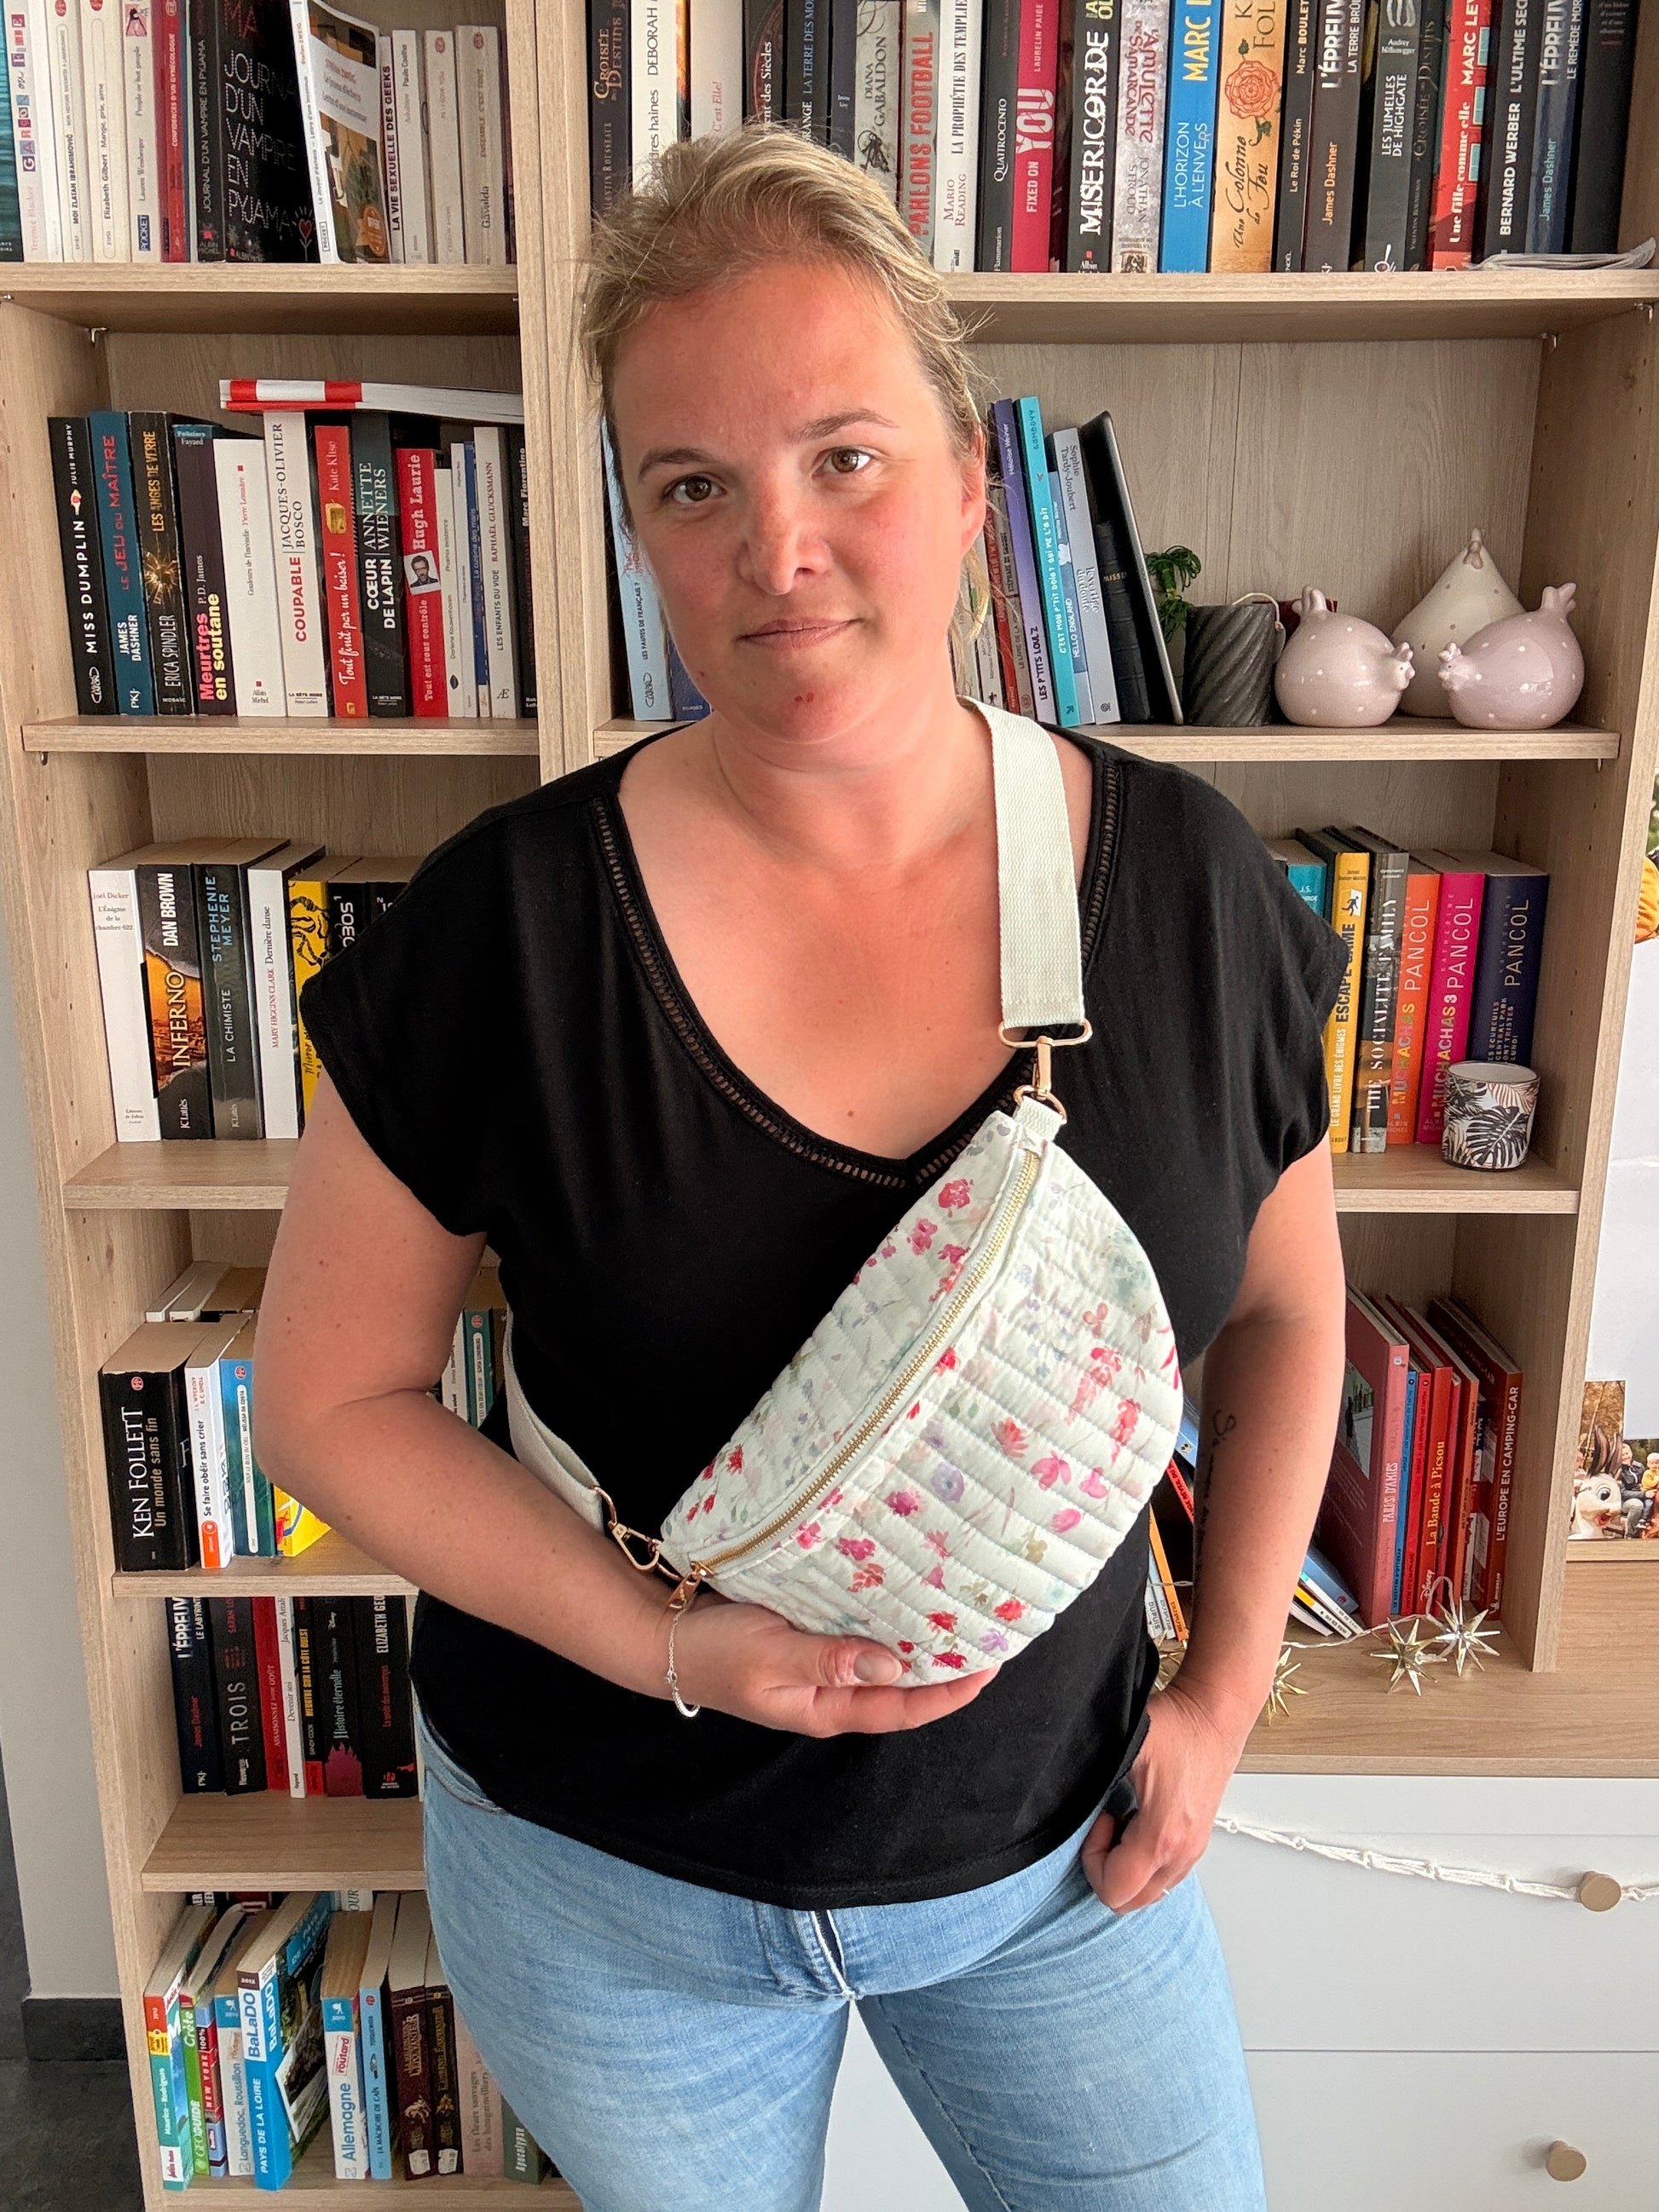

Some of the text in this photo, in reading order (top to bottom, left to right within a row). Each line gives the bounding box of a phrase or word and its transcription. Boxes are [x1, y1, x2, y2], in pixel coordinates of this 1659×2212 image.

[647, 7, 659, 130] haines DEBORAH
[761, 42, 772, 101] des Siècles
[1033, 3, 1043, 72] LAURELIN PAIGE
[1182, 16, 1211, 81] MARC
[1296, 0, 1309, 74] Marc BOULET
[1347, 26, 1360, 72] LA TERRE
[1567, 25, 1581, 79] LE REMÈDE
[864, 62, 873, 99] DIANA
[875, 36, 886, 127] GABALDON
[1381, 75, 1396, 154] LES JUMELLES
[1393, 74, 1407, 156] DE HIGHGATE
[198, 40, 211, 212] JOURNAL D'UN VAMPIRE EN PYJAMA
[383, 66, 400, 231] LA VIE SEXUELLE DES GEEKS
[908, 32, 933, 236] PARLONS FOOTBALL
[1015, 88, 1054, 212] FIXED ON YOU
[1079, 31, 1108, 235] MISERICORDE
[1289, 118, 1302, 192] Le Roi de Pékin
[1500, 29, 1526, 235] BERNARD WERBER L'ULTIME
[100, 154, 109, 181] Gilbert
[101, 184, 111, 219] Elizabeth
[1125, 164, 1136, 214] STROUD
[1137, 157, 1149, 222] JONATHAN
[1174, 123, 1189, 207] L'HORIZON
[1322, 141, 1338, 225] James Dashner
[1449, 101, 1470, 243] Une fille comme elle
[1540, 138, 1557, 221] James Dashner
[139, 215, 149, 251] POCKET
[994, 227, 1003, 271] Flammarion
[66, 424, 78, 485] JULIE MURPHY
[272, 423, 294, 549] JACQUES-OLIVIER
[1061, 447, 1076, 511] Tardy-Joubert
[1069, 445, 1080, 476] Sophie
[101, 435, 130, 590] LE JEU DU MAÎTRE
[292, 500, 306, 548] BOSCO
[359, 462, 377, 550] ANNETTE
[373, 468, 390, 550] WIENERS
[408, 454, 427, 550] Hugh Laurie
[73, 520, 98, 654] MISS DUMPLIN
[194, 555, 206, 604] P.D. James
[290, 557, 307, 642] COUPABLE
[366, 558, 379, 610] CŒUR
[380, 559, 396, 628] DE LAPIN
[493, 589, 501, 599] DU
[118, 621, 130, 655] JAMES
[128, 615, 142, 661] DASHNER
[159, 614, 182, 687] ERICA SPINDLER
[194, 613, 214, 700] Meurtres
[208, 593, 228, 701] en soutane
[419, 599, 433, 702] Tout est sous contrôle
[1066, 598, 1080, 657] HELLO ENGLAND
[158, 873, 179, 946] DAN BROWN
[205, 876, 223, 962] STEPHENIE
[220, 893, 233, 946] MEYER
[262, 906, 275, 964] Dernière danse
[1403, 899, 1431, 990] PANCOL
[1446, 898, 1474, 989] PANCOL
[1503, 899, 1529, 986] PANCOL
[165, 971, 191, 1066] INFERNO
[221, 990, 236, 1062] LA CHIMISTE
[1366, 899, 1397, 1112] THE SOCIALITE FAMILY
[1494, 997, 1508, 1060] CENTRAL PARK
[1330, 1028, 1346, 1127] LE GRAND LIVRE DES ÉNIGMES
[1392, 1002, 1414, 1104] MUCHACHAS
[121, 1406, 154, 1538] KEN FOLLETT
[146, 1417, 167, 1527] Un monde sans fin
[195, 1419, 212, 1516] Se faire obéir sans crier
[1384, 1462, 1399, 1493] D'AMIES
[1432, 1441, 1446, 1479] Picsou
[1495, 1386, 1520, 1541] L'EUROPE EN CAMPING-CAR
[1425, 1530, 1437, 1545] La
[1426, 1493, 1442, 1528] Bande
[281, 1618, 290, 1643] Jacques
[374, 1614, 389, 1653] ELIZABETH
[228, 1682, 249, 1744] TROIS
[198, 2028, 207, 2050] 100%
[337, 2036, 350, 2073] routard
[200, 2054, 212, 2108] NEW YORK
[231, 2063, 250, 2162] Languedoc, Roussillon
[253, 2078, 269, 2174] PAYS DE LA LOIRE
[338, 2083, 357, 2162] Allemagne
